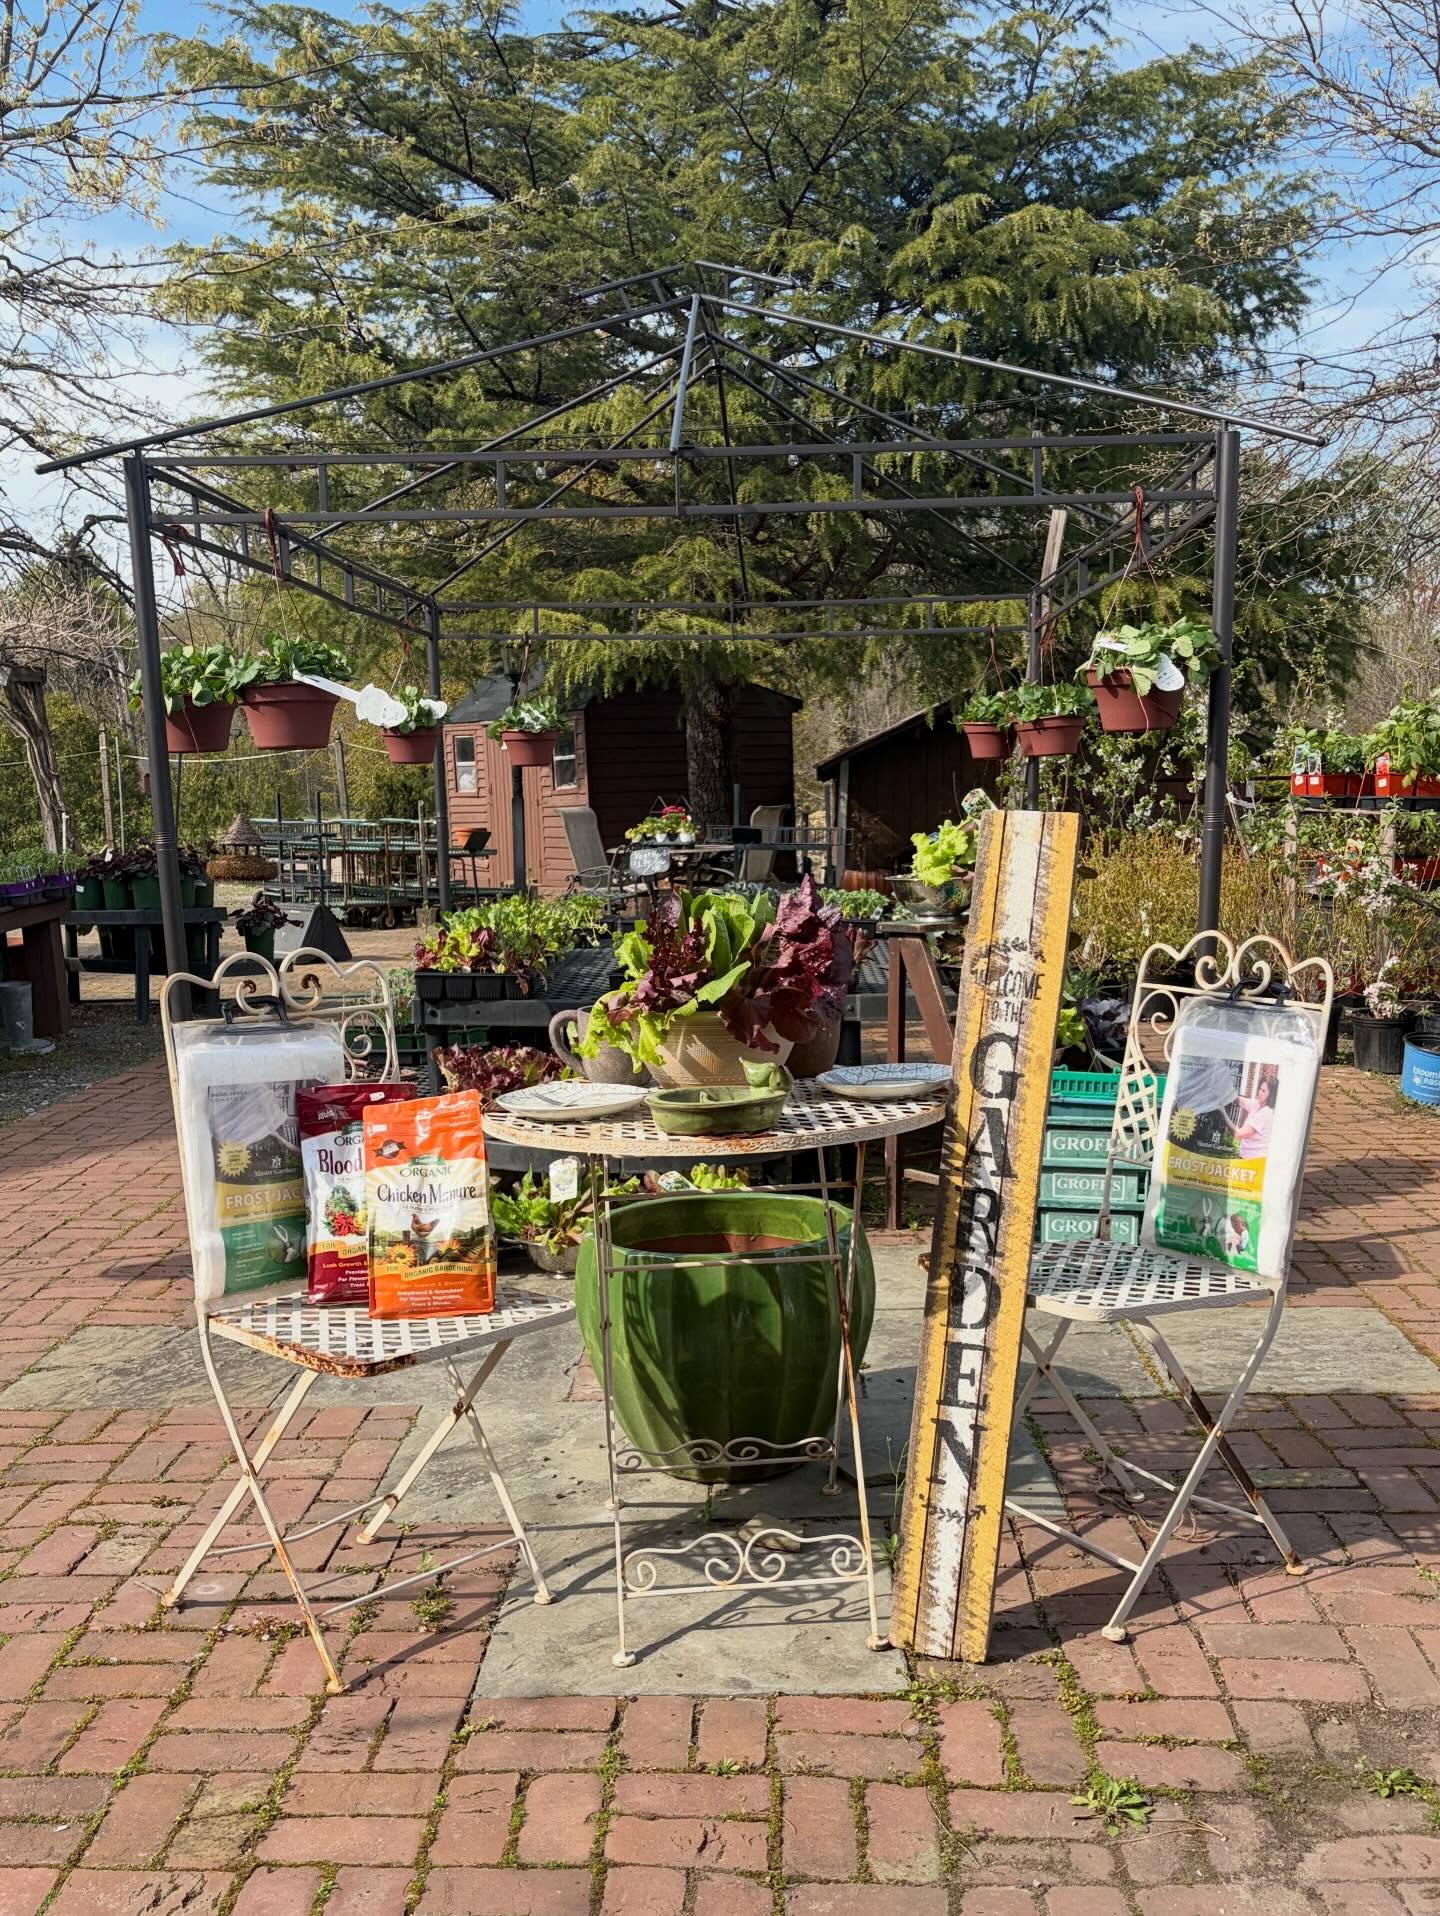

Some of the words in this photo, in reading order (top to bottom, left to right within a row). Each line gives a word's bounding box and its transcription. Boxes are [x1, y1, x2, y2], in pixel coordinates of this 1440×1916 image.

[973, 967, 1045, 1000] WLCOME
[1004, 1001, 1027, 1024] THE
[317, 1147, 363, 1175] Blood
[400, 1165, 457, 1177] ORGANIC
[1168, 1156, 1206, 1175] FROST
[1208, 1165, 1257, 1183] JACKET
[377, 1184, 427, 1205] Chicken
[1056, 1177, 1121, 1192] GROFS
[225, 1190, 271, 1209] FROST
[1050, 1218, 1130, 1235] GRO'S
[404, 1266, 433, 1279] ORGANIC
[434, 1264, 473, 1273] GARDENING
[925, 1031, 1026, 1491] GARDEN
